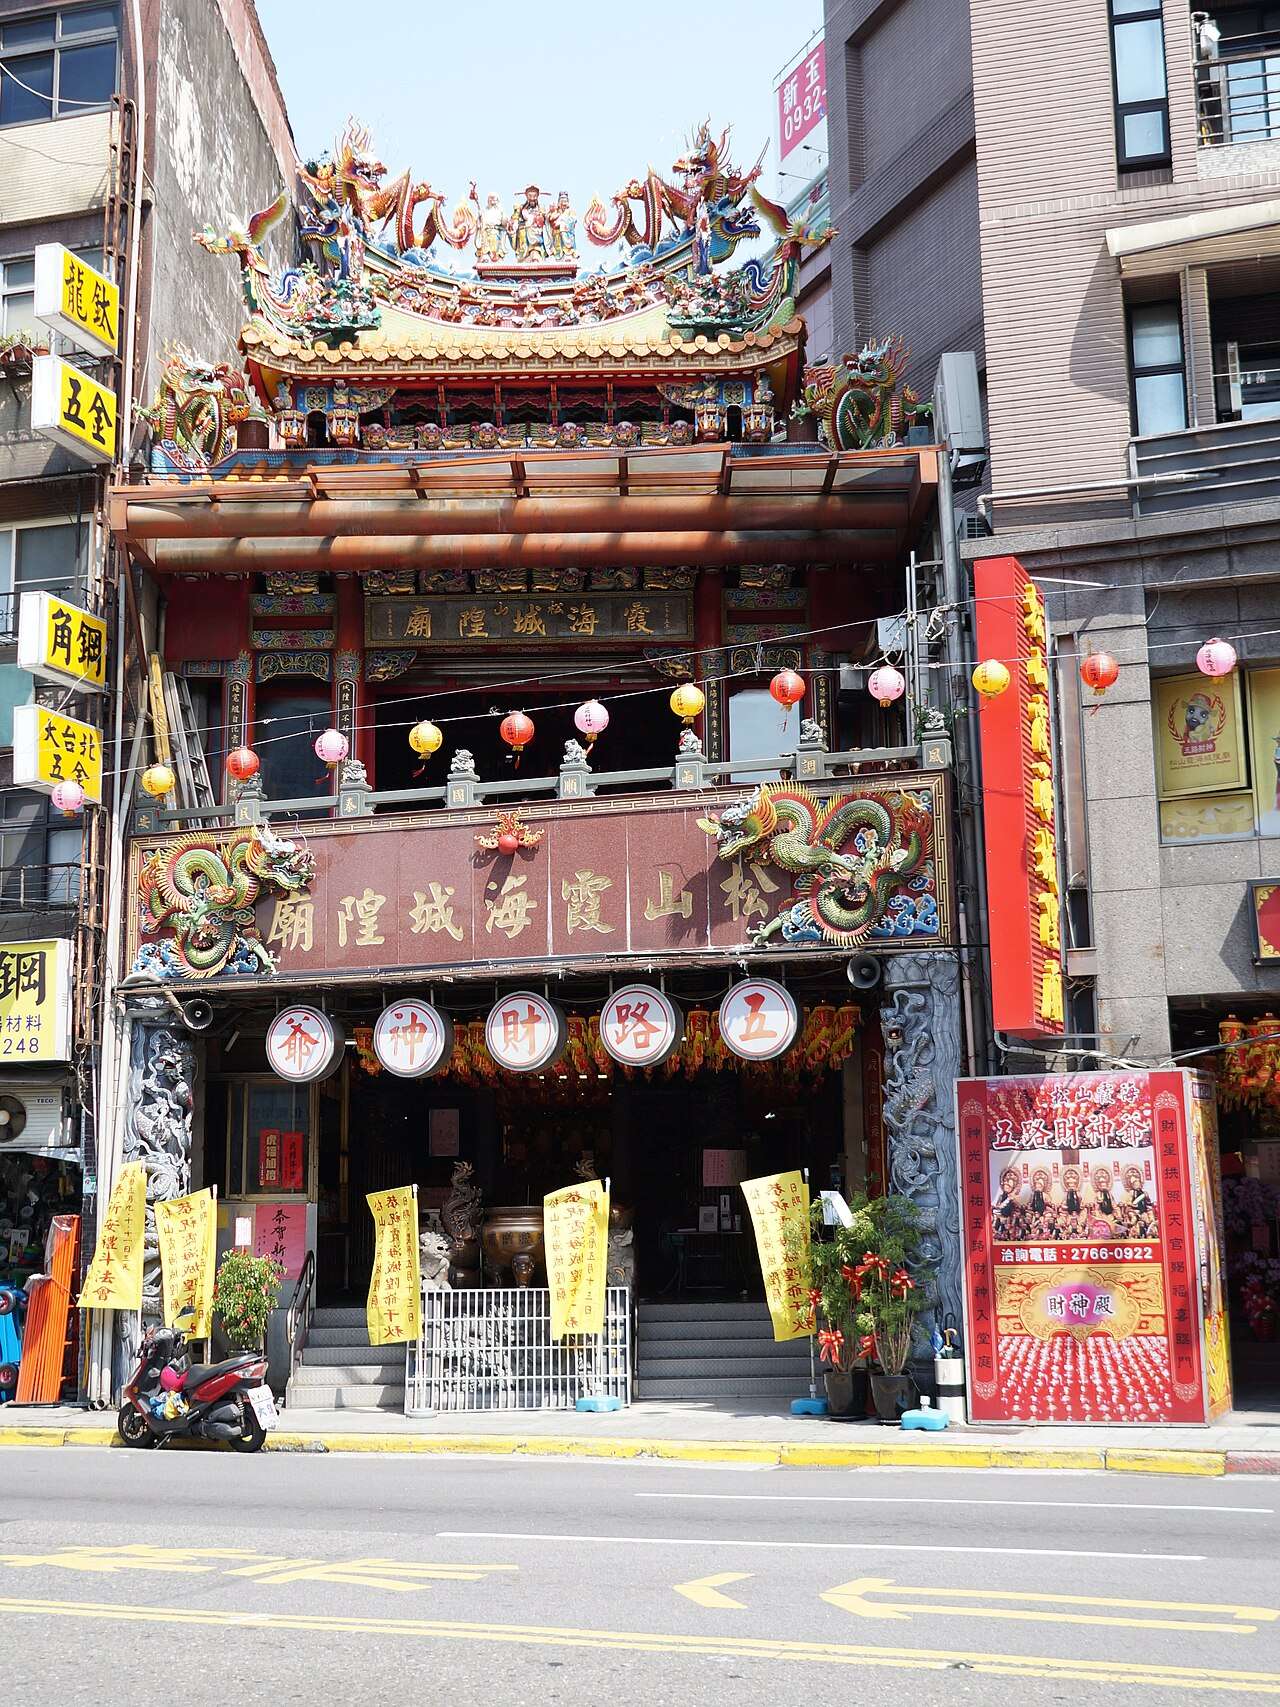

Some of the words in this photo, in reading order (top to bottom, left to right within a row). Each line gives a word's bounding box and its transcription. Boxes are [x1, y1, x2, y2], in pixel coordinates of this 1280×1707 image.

[63, 376, 112, 445] 五金
[403, 600, 655, 639] 霞海城隍廟
[51, 607, 101, 678] 角鋼
[44, 718, 96, 762] 大台北
[49, 753, 90, 790] 五金
[801, 759, 816, 775] 調
[452, 789, 466, 803] 國
[563, 776, 578, 794] 順
[343, 796, 358, 814] 泰
[266, 861, 780, 952] 松山霞海城隍廟
[0, 1014, 41, 1033] 材料
[277, 992, 778, 1072] 五路財神爺
[3, 1037, 39, 1055] 248
[1051, 1082, 1140, 1105] 松山霞海
[991, 1112, 1150, 1150] 五路財神爺
[1048, 1292, 1114, 1318] 財神殿
